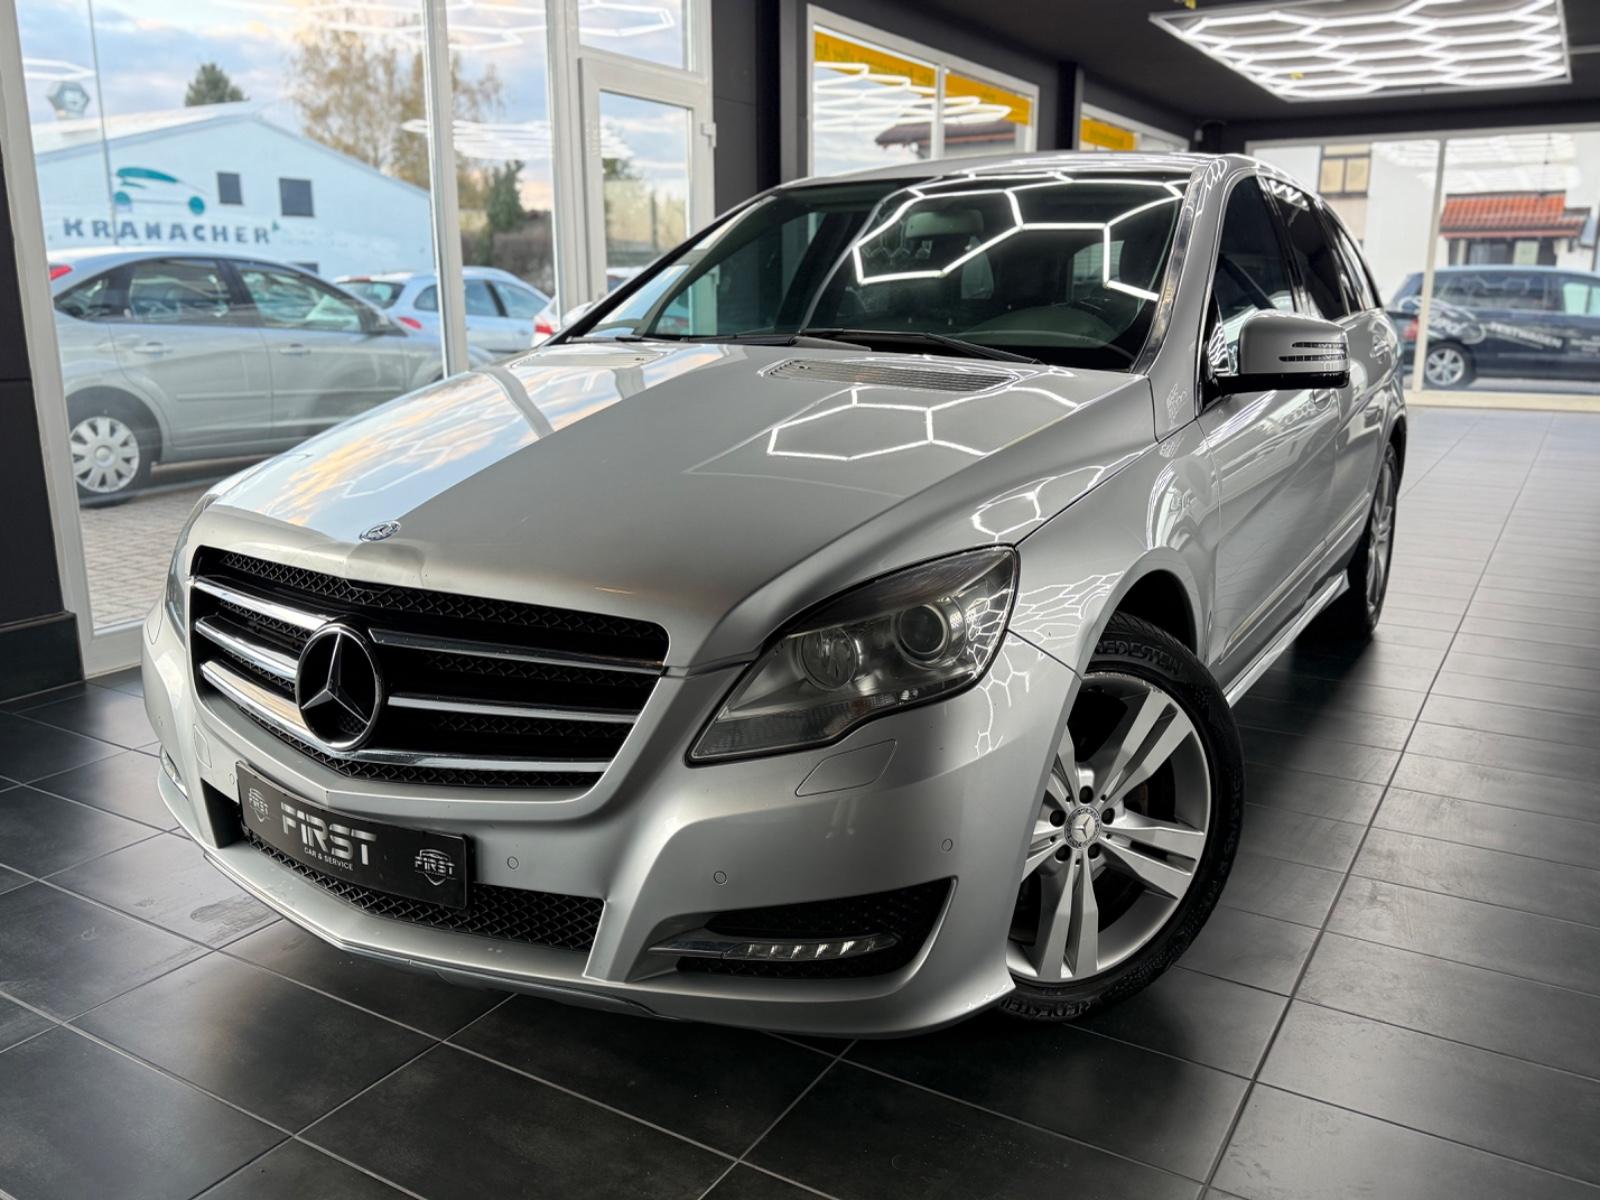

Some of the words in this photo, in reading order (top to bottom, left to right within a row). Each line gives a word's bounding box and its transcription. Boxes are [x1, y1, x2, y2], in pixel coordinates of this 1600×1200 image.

[280, 801, 377, 866] FIRST
[324, 855, 353, 871] SERVICE
[415, 856, 455, 876] FIRST
